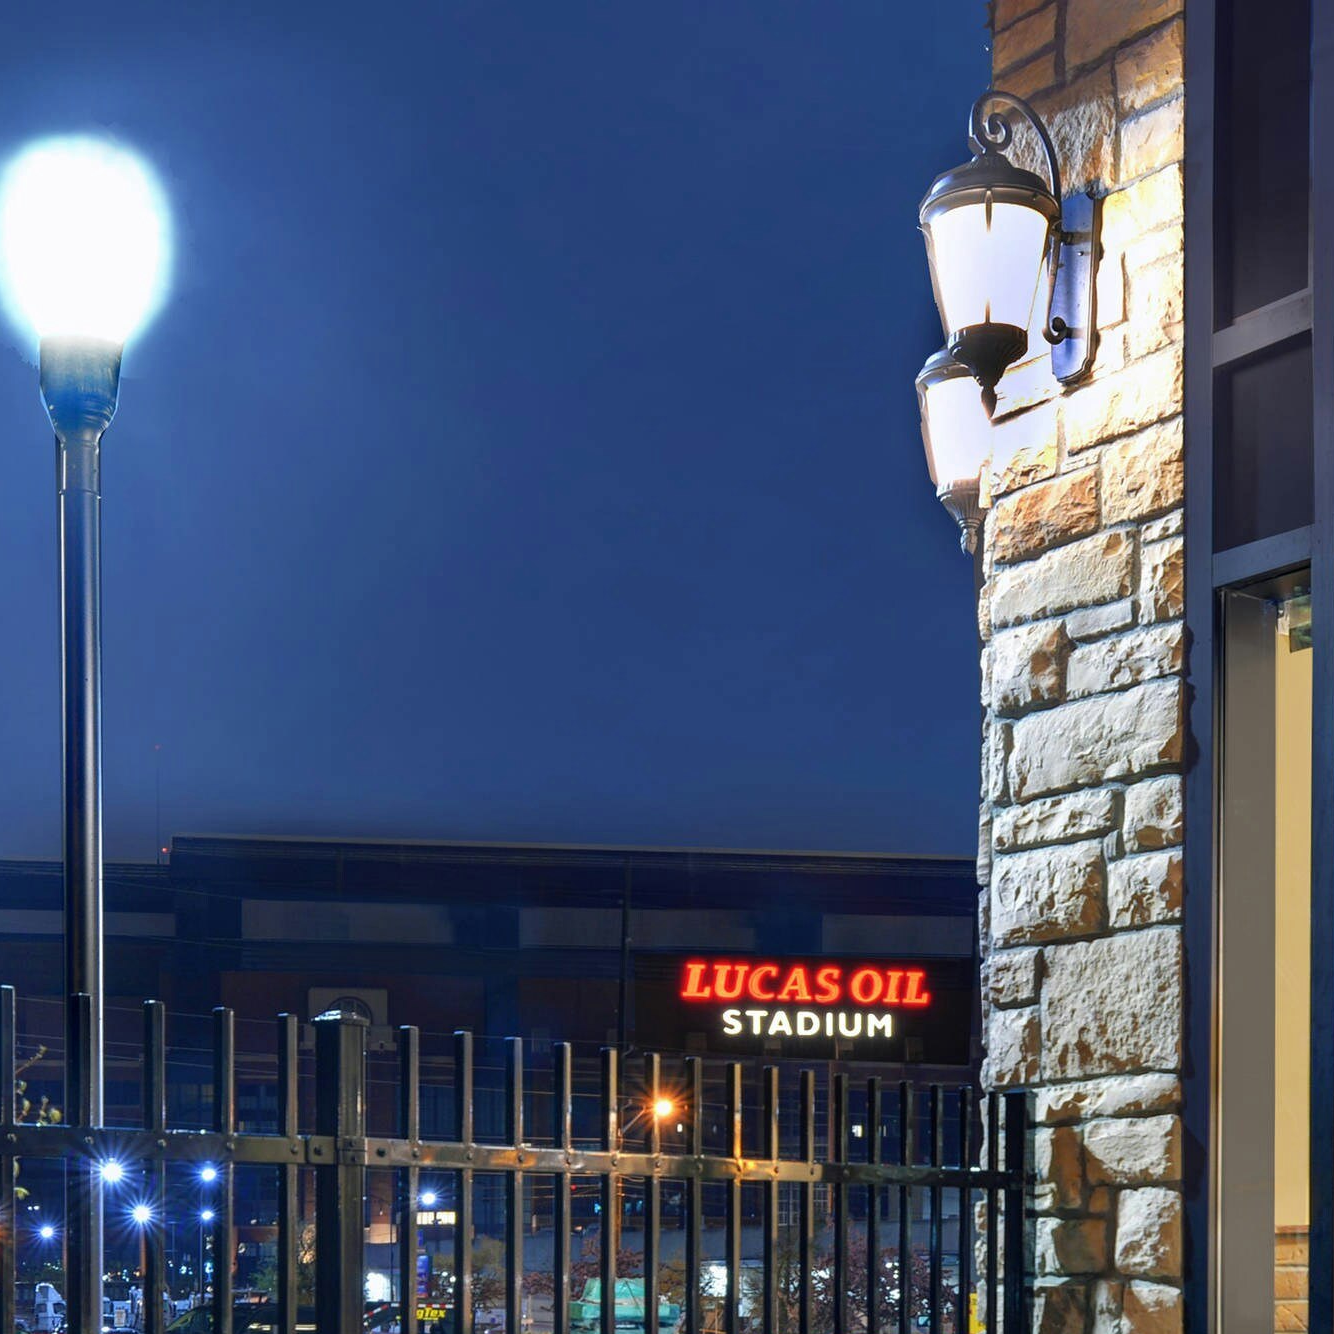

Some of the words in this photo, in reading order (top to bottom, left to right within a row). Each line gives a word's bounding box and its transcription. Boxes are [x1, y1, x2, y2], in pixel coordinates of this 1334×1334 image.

[680, 962, 841, 1003] LUCAS
[850, 969, 930, 1005] OIL
[722, 1008, 892, 1038] STADIUM
